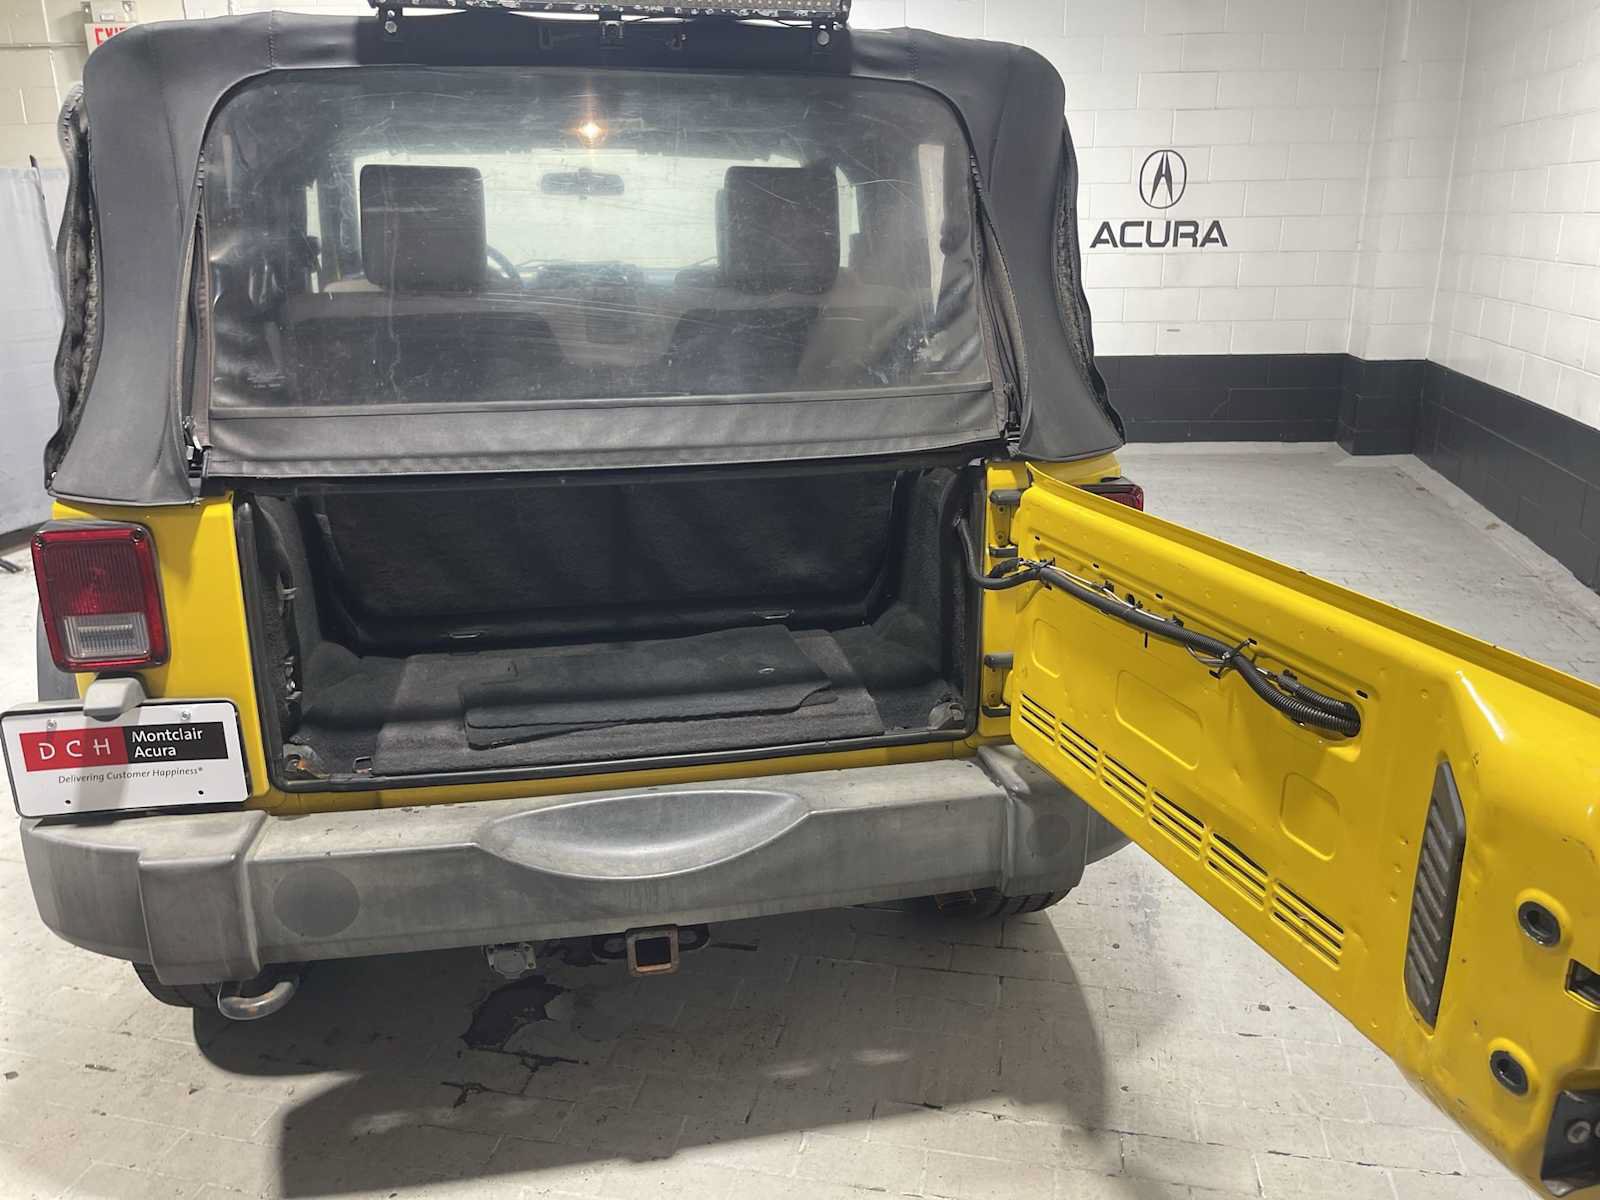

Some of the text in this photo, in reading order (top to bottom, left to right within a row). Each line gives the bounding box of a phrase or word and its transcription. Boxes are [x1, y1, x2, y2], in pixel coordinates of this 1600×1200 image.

[95, 27, 126, 47] EX
[1089, 220, 1228, 248] ACURA
[132, 728, 203, 743] Montclair
[134, 746, 177, 758] Acura
[58, 773, 104, 784] Delivering
[106, 770, 150, 780] Customer
